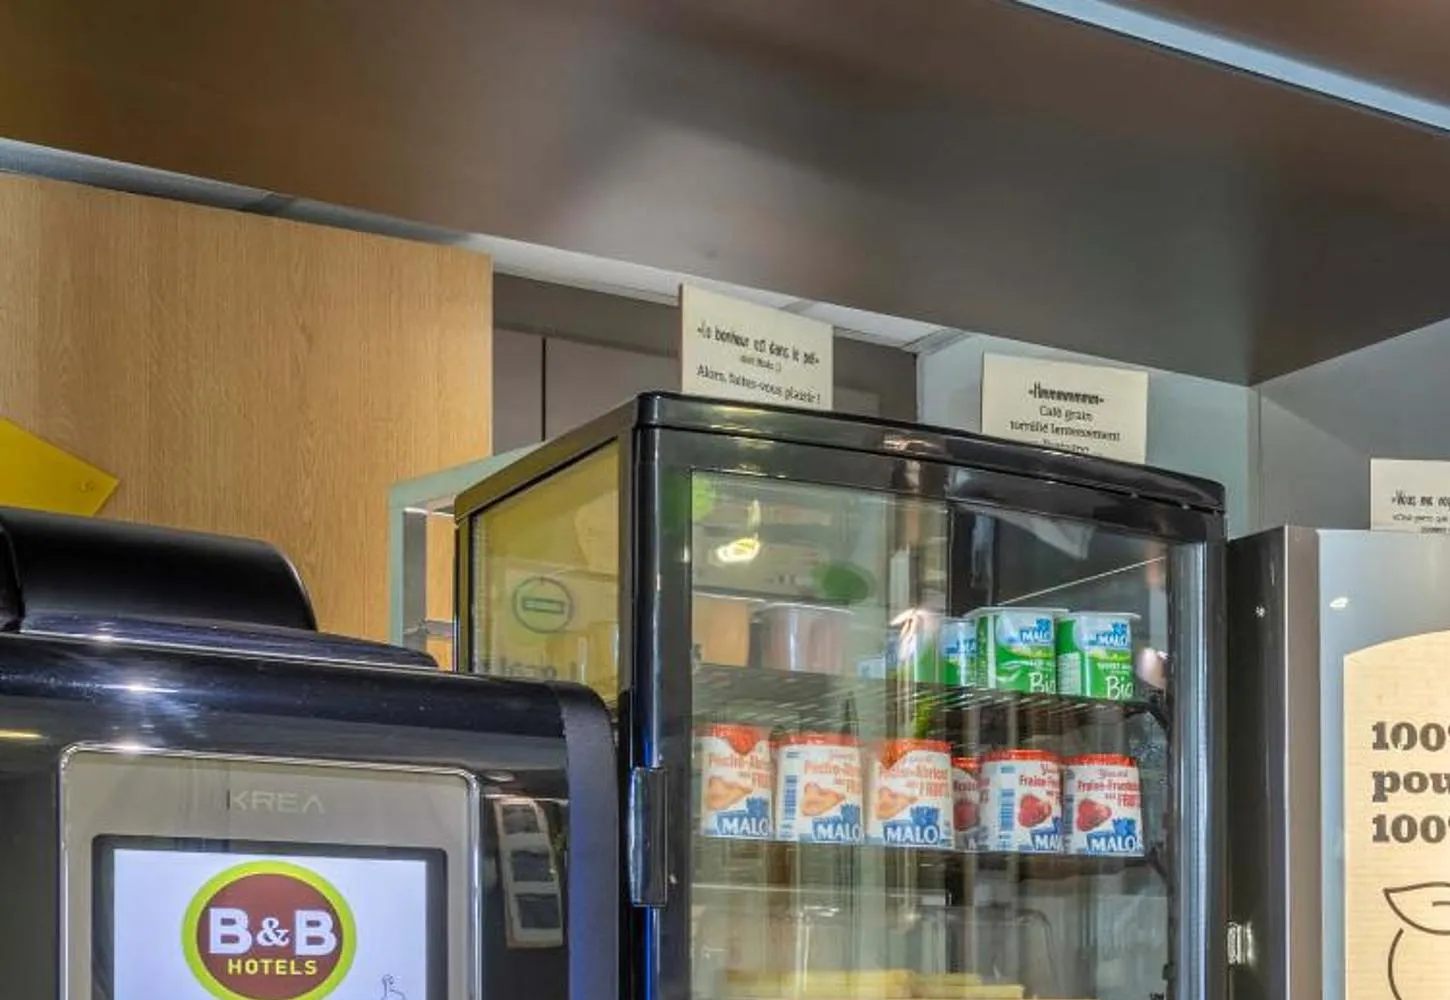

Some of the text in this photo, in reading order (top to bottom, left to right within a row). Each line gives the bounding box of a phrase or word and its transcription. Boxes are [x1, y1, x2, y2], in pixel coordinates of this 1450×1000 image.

[229, 790, 326, 814] KREA
[886, 824, 939, 845] MALO
[209, 908, 338, 957] B&B
[227, 958, 318, 976] HOTELS
